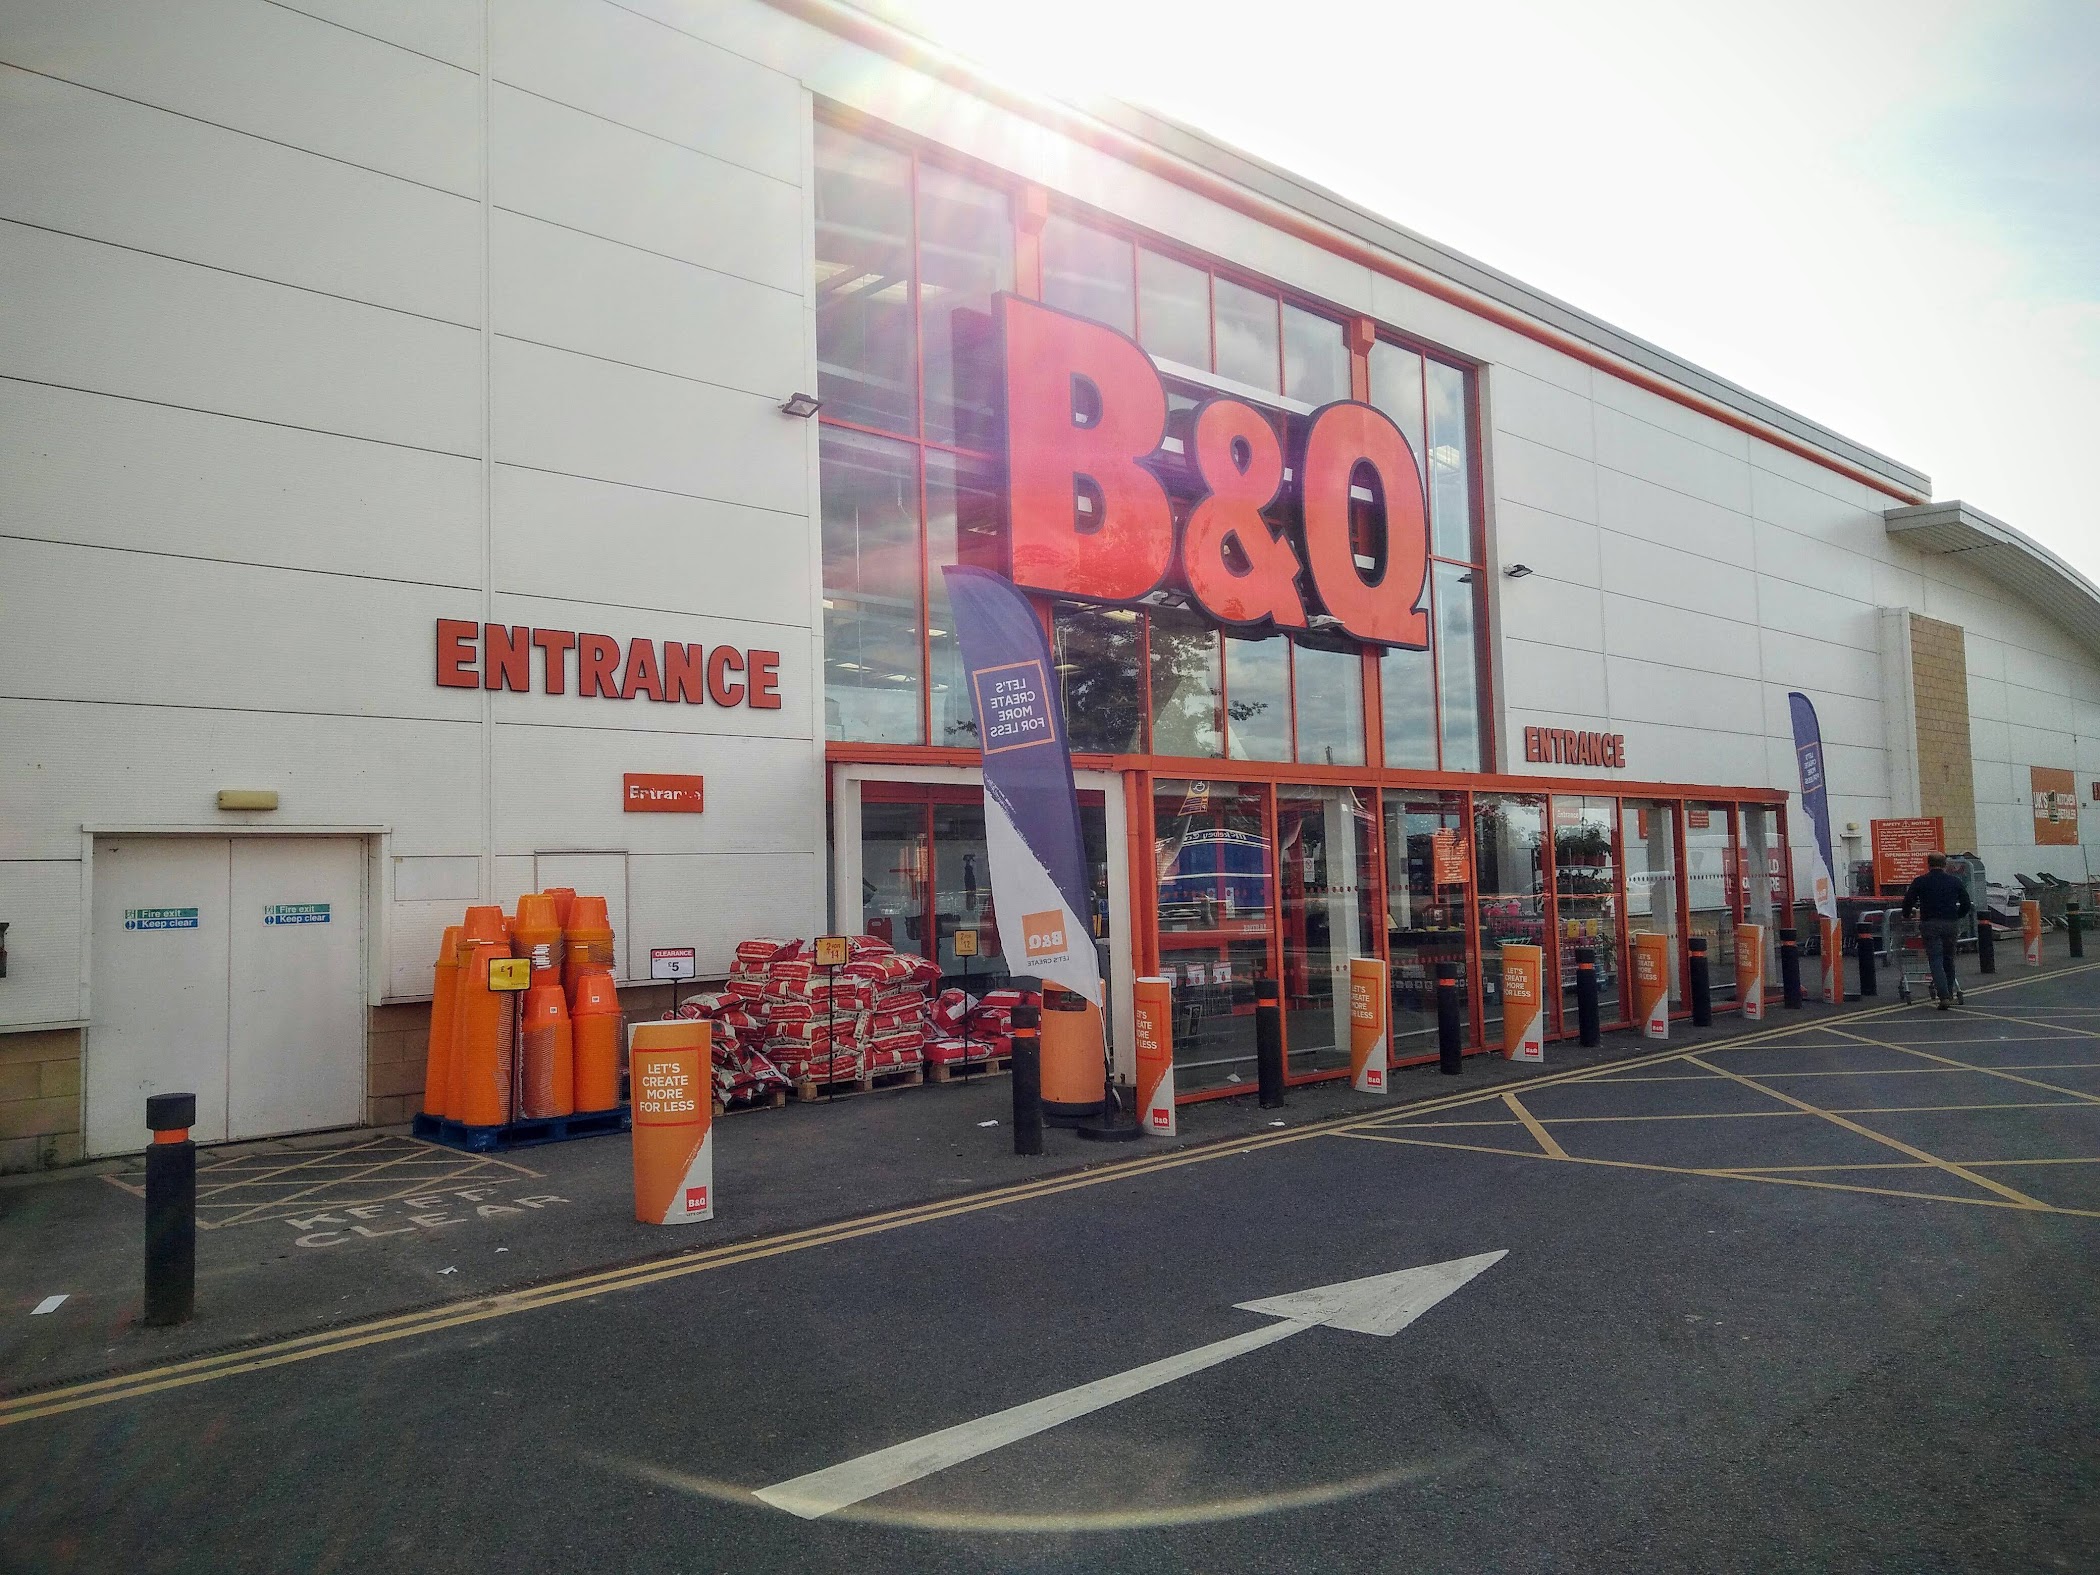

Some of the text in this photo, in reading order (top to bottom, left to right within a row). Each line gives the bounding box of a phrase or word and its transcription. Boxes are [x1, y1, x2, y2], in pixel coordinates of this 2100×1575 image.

[991, 290, 1429, 651] B&Q
[436, 618, 782, 709] ENTRANCE
[1525, 726, 1625, 767] ENTRANCE
[142, 909, 182, 918] Fire exit
[279, 905, 314, 914] Fire exit
[142, 918, 193, 928] Keep clear
[279, 914, 325, 924] Keep clear
[826, 942, 832, 950] 2
[500, 965, 514, 978] £1
[668, 961, 680, 972] £5
[1504, 974, 1528, 982] CREATE
[1357, 1011, 1374, 1020] LESS
[1138, 1032, 1150, 1040] ORE
[1140, 1040, 1158, 1050] LESS
[648, 1063, 681, 1074] LET'S
[642, 1075, 689, 1087] CREATE
[646, 1088, 684, 1100] MORE
[640, 1100, 694, 1112] FOR LESS
[1154, 1116, 1168, 1125] B&Q
[688, 1196, 706, 1208] B&Q
[295, 1195, 571, 1248] CLEAR
